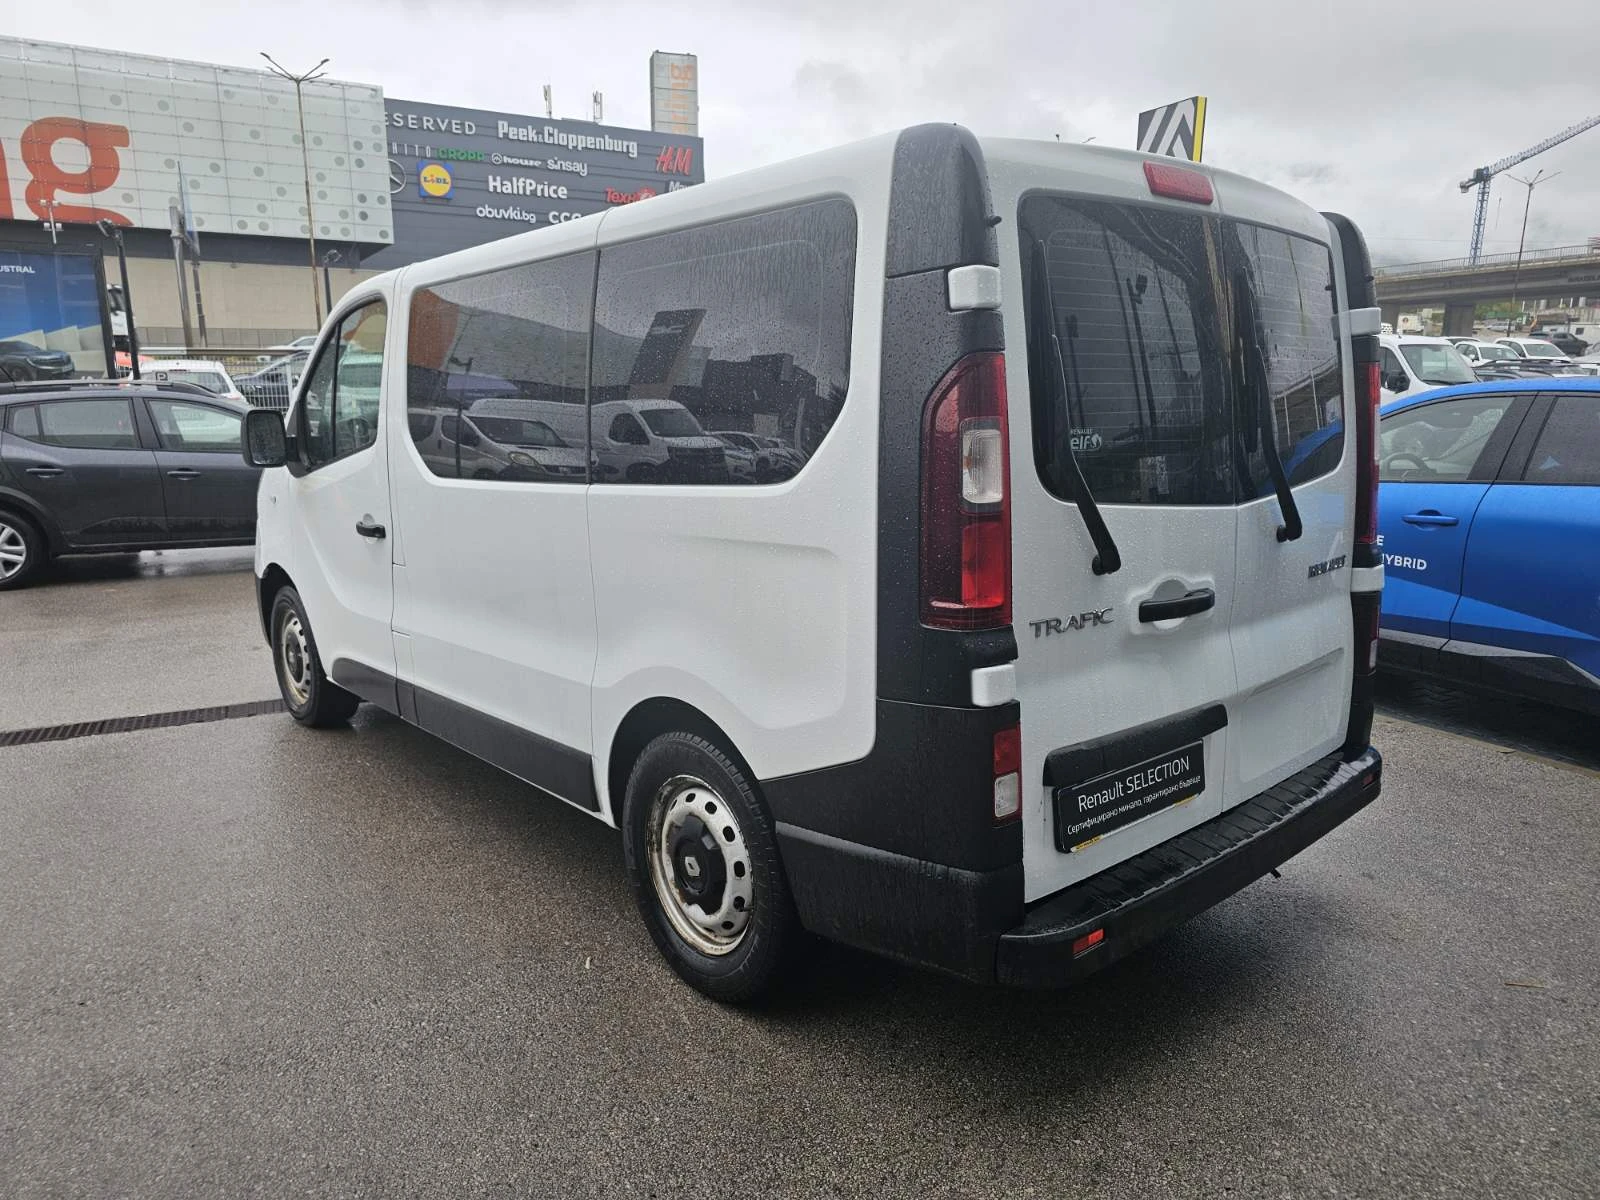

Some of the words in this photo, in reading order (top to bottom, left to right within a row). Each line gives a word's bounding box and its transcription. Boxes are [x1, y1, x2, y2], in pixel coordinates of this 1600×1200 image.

[438, 147, 486, 161] CROPP
[503, 155, 542, 168] house
[655, 144, 694, 177] H&M
[546, 156, 588, 177] sinsay
[487, 174, 569, 200] HalfPrice
[476, 203, 537, 224] obuvki.bg
[1070, 435, 1091, 450] elf
[1029, 606, 1114, 639] TRAFIC
[1077, 781, 1125, 813] Renault
[1126, 755, 1190, 794] SELECTION
[1067, 806, 1118, 835] Сертифицирано
[1143, 783, 1179, 804] гарантирано
